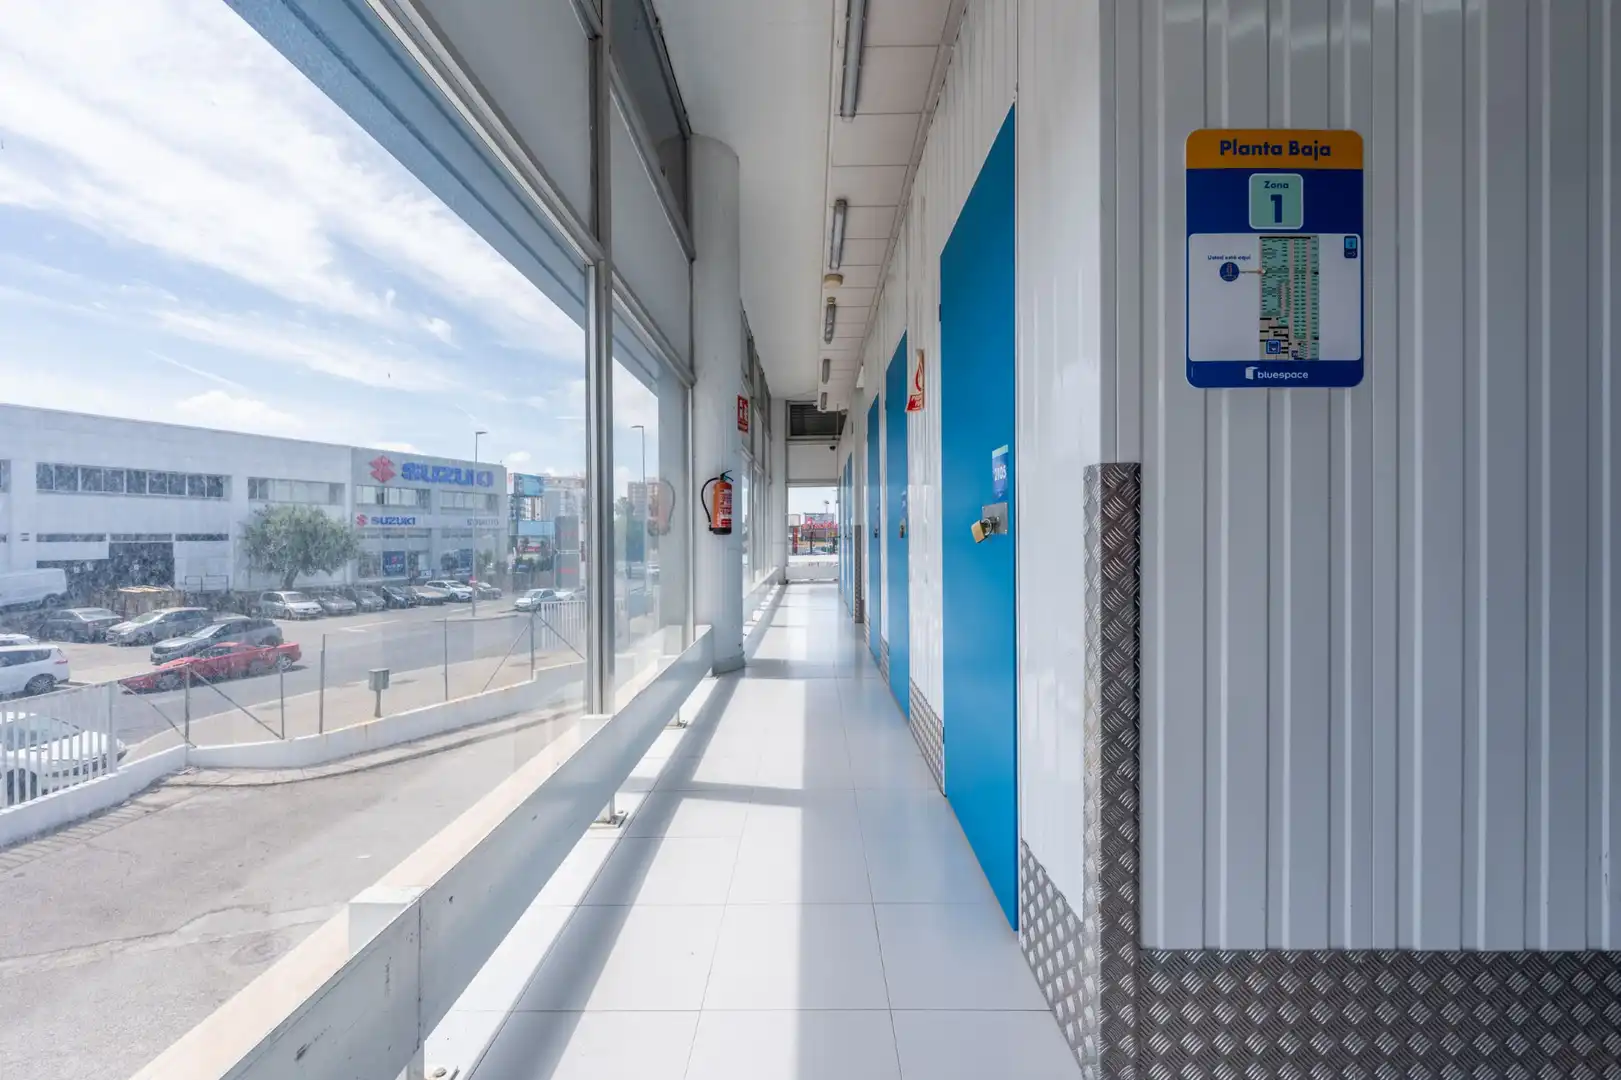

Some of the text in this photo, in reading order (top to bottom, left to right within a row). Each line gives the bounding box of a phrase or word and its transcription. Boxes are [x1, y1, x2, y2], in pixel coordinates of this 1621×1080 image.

[1219, 139, 1331, 161] Planta Baja
[1264, 181, 1289, 189] Zona
[1270, 194, 1283, 223] 1
[1257, 371, 1308, 380] bluespace
[401, 462, 494, 487] SUZUKI
[371, 516, 416, 526] SUZUKI
